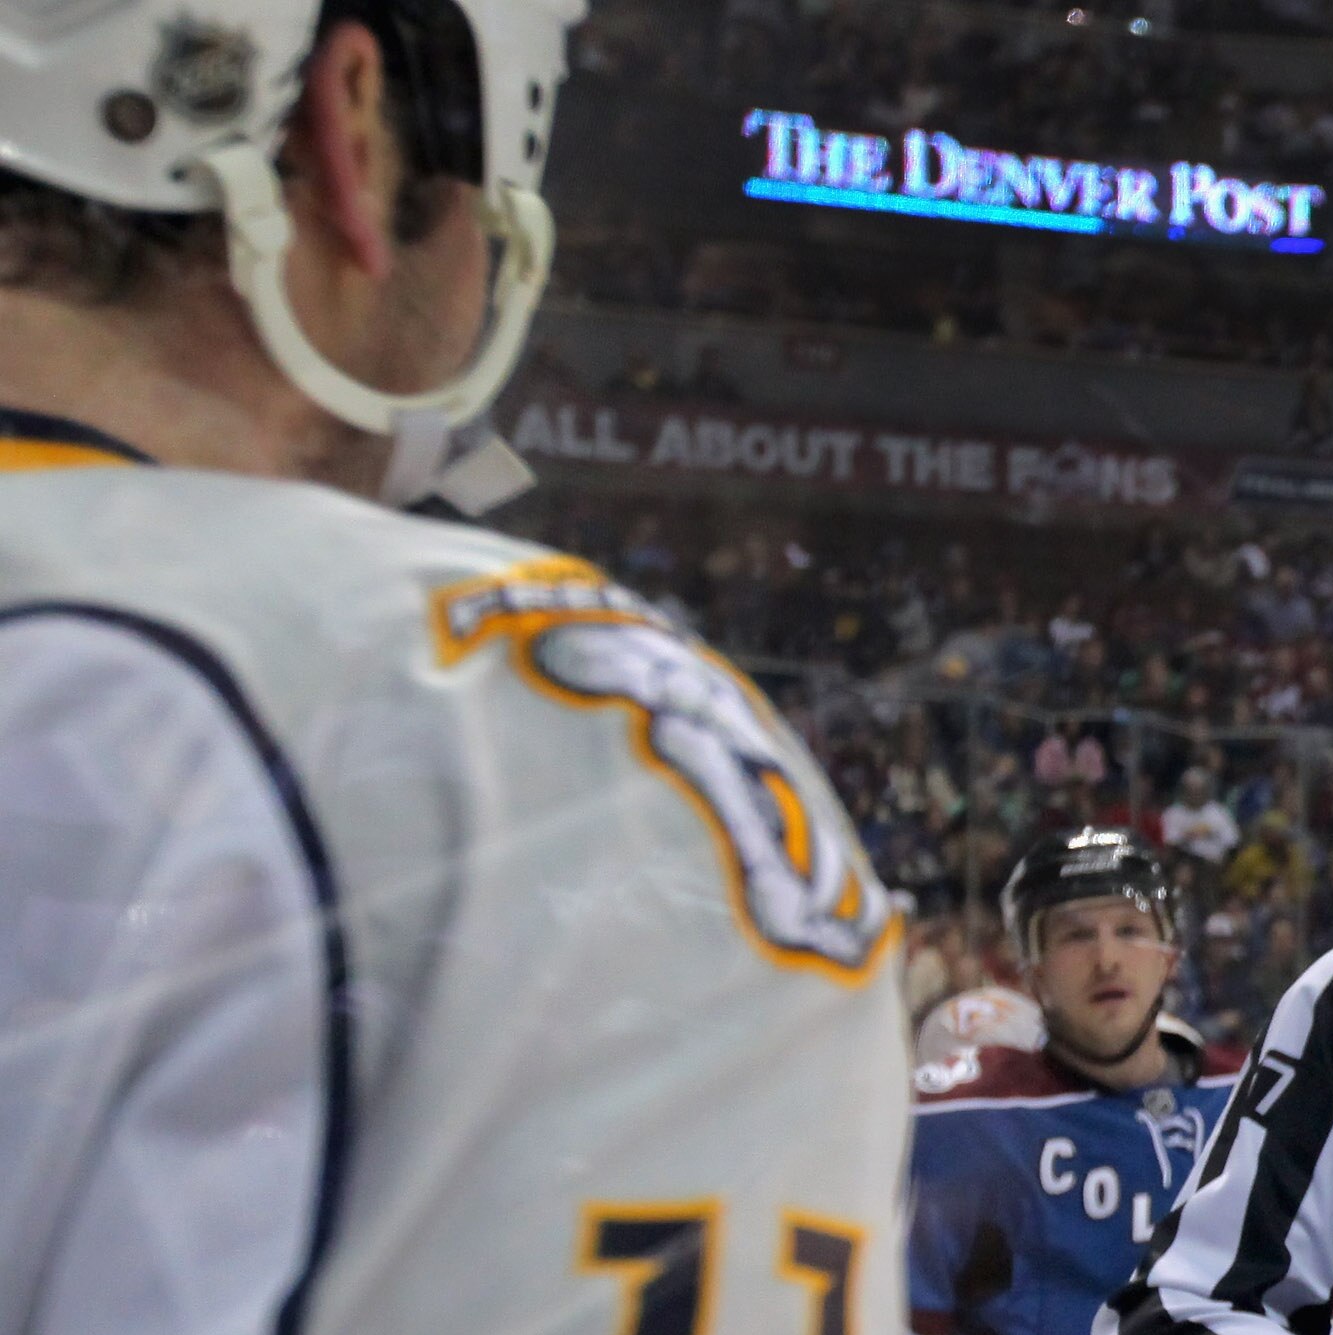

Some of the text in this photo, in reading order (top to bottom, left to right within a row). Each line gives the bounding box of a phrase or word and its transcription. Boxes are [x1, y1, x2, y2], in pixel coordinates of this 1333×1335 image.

[903, 127, 1158, 225] DENVER
[1169, 160, 1325, 237] POST
[512, 402, 637, 463] ALL
[651, 415, 862, 482] ABOUT
[874, 434, 996, 492] THE
